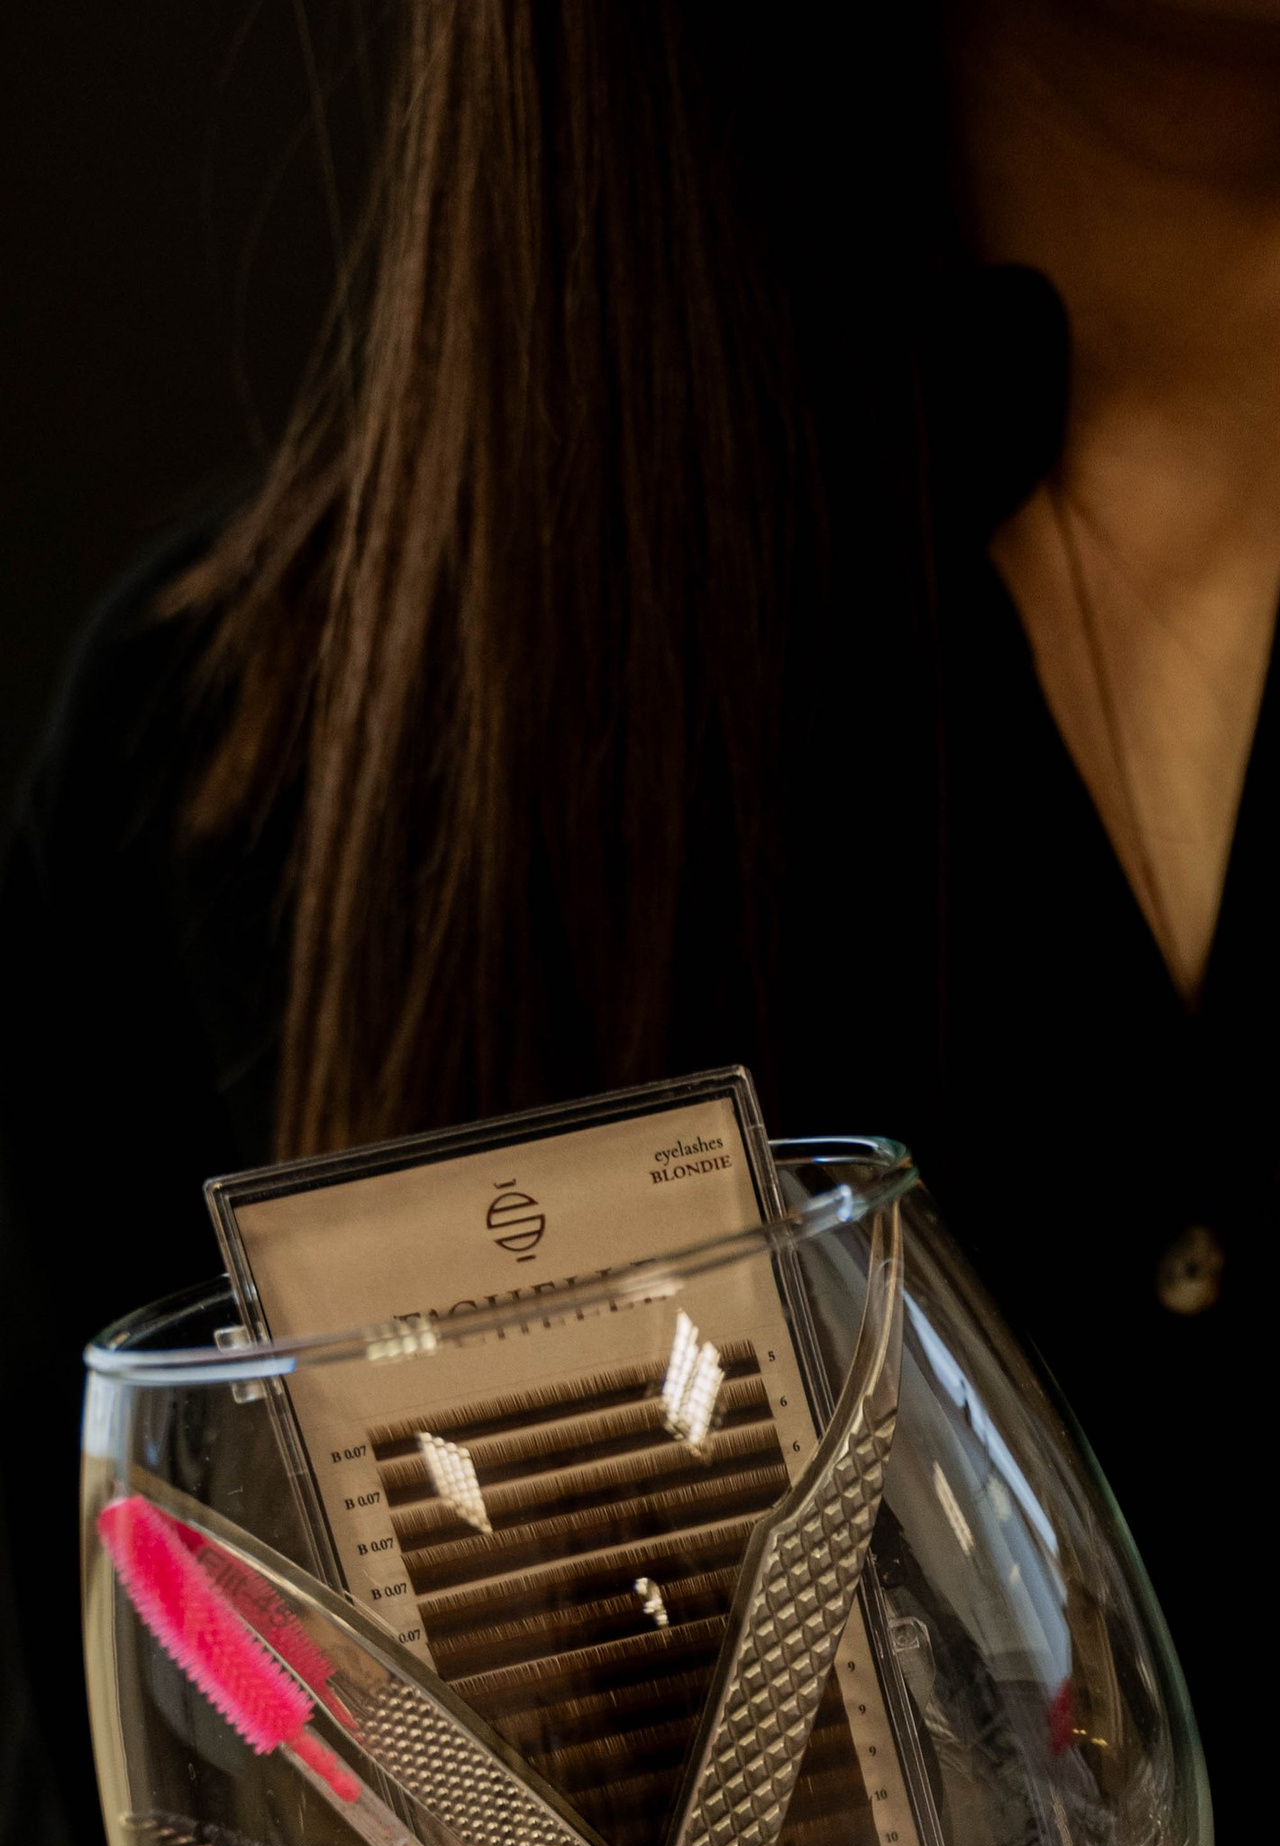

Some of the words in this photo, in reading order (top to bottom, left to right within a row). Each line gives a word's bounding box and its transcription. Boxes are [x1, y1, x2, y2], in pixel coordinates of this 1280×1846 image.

[654, 1135, 724, 1166] eyelashes
[649, 1154, 733, 1184] BLONDIE
[767, 1350, 776, 1362] 5
[779, 1395, 788, 1407] 6
[792, 1440, 801, 1452] 6
[330, 1451, 342, 1463] B
[344, 1445, 367, 1460] 0.07
[344, 1498, 356, 1511] B
[357, 1491, 381, 1507] 0.07
[357, 1543, 369, 1556] B
[370, 1537, 394, 1553] 0.07
[370, 1588, 382, 1601] B
[384, 1582, 407, 1598] 0.07
[398, 1629, 421, 1644] 0.07
[847, 1660, 856, 1672] 9
[858, 1703, 867, 1715] 9
[868, 1745, 877, 1757] 9
[874, 1788, 888, 1801] 10
[885, 1831, 899, 1843] 10
